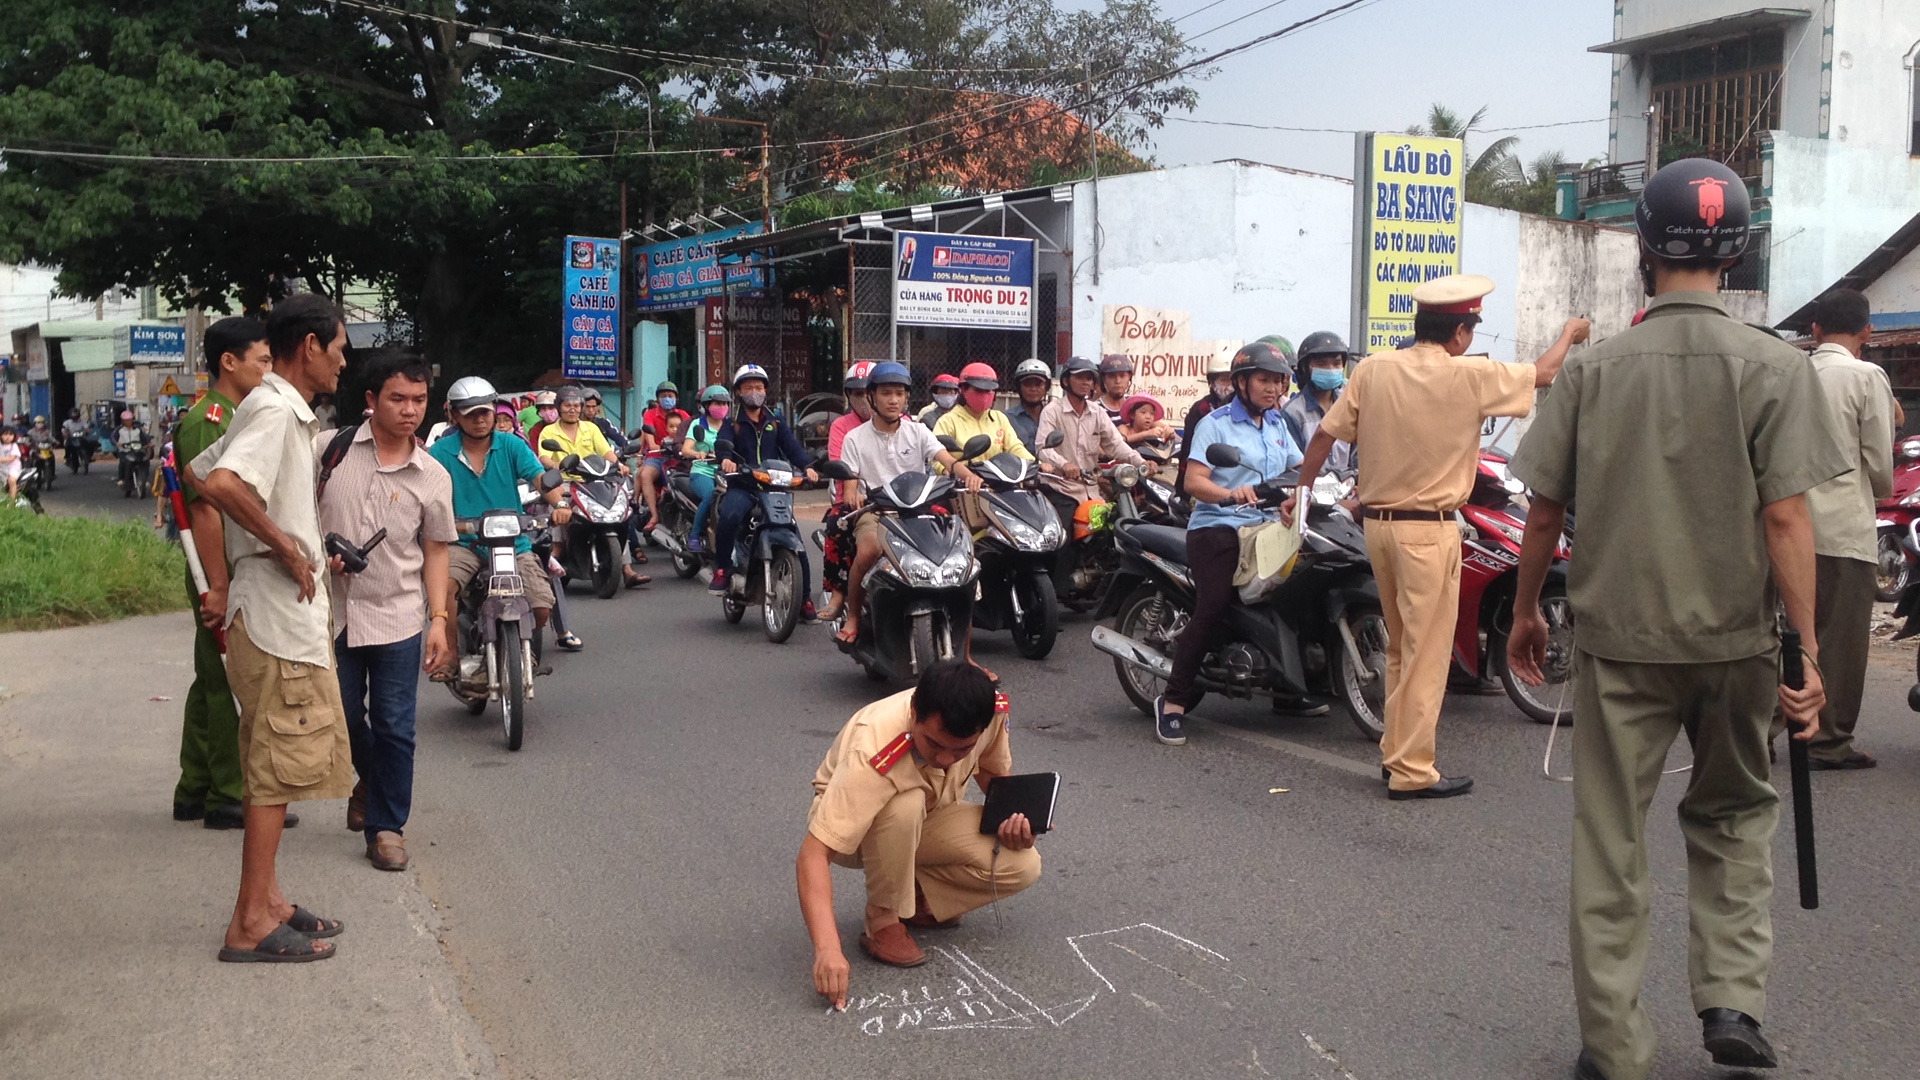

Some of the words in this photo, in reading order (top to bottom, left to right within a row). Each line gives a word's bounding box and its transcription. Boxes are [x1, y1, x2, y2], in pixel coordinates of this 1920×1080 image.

[1384, 144, 1421, 174] LẨU
[1426, 149, 1452, 176] BÒ
[1376, 182, 1402, 221] BA
[1405, 184, 1457, 223] SANG
[1375, 225, 1388, 251] BÒ
[1406, 233, 1425, 253] RAU
[1428, 228, 1456, 254] RỪNG
[1666, 225, 1693, 234] Catch
[1712, 226, 1719, 234] if
[1720, 227, 1734, 235] you
[653, 244, 685, 267] CAFÉ
[952, 251, 1009, 266] DAPHACO
[651, 270, 675, 290] CÂU
[677, 266, 694, 286] CÁ
[933, 272, 951, 280] 100%
[952, 272, 968, 282] Đồng
[1376, 257, 1395, 282] CÁC
[1397, 258, 1421, 283] MÓN
[580, 274, 609, 291] CAFÉ
[570, 290, 599, 308] CẢNH
[900, 288, 917, 300] CỬA
[919, 290, 942, 301] HÀNG
[946, 287, 993, 306] TRỌNG
[997, 290, 1016, 305] DU
[1020, 291, 1028, 306] 2
[713, 306, 757, 321] KOAN
[761, 304, 800, 321] GING
[1113, 305, 1176, 339] Bán
[573, 314, 595, 331] CÂU
[597, 315, 613, 332] CÁ
[570, 332, 594, 350] GIẢI
[596, 335, 615, 351] TRÍ
[1141, 353, 1184, 377] BƠM
